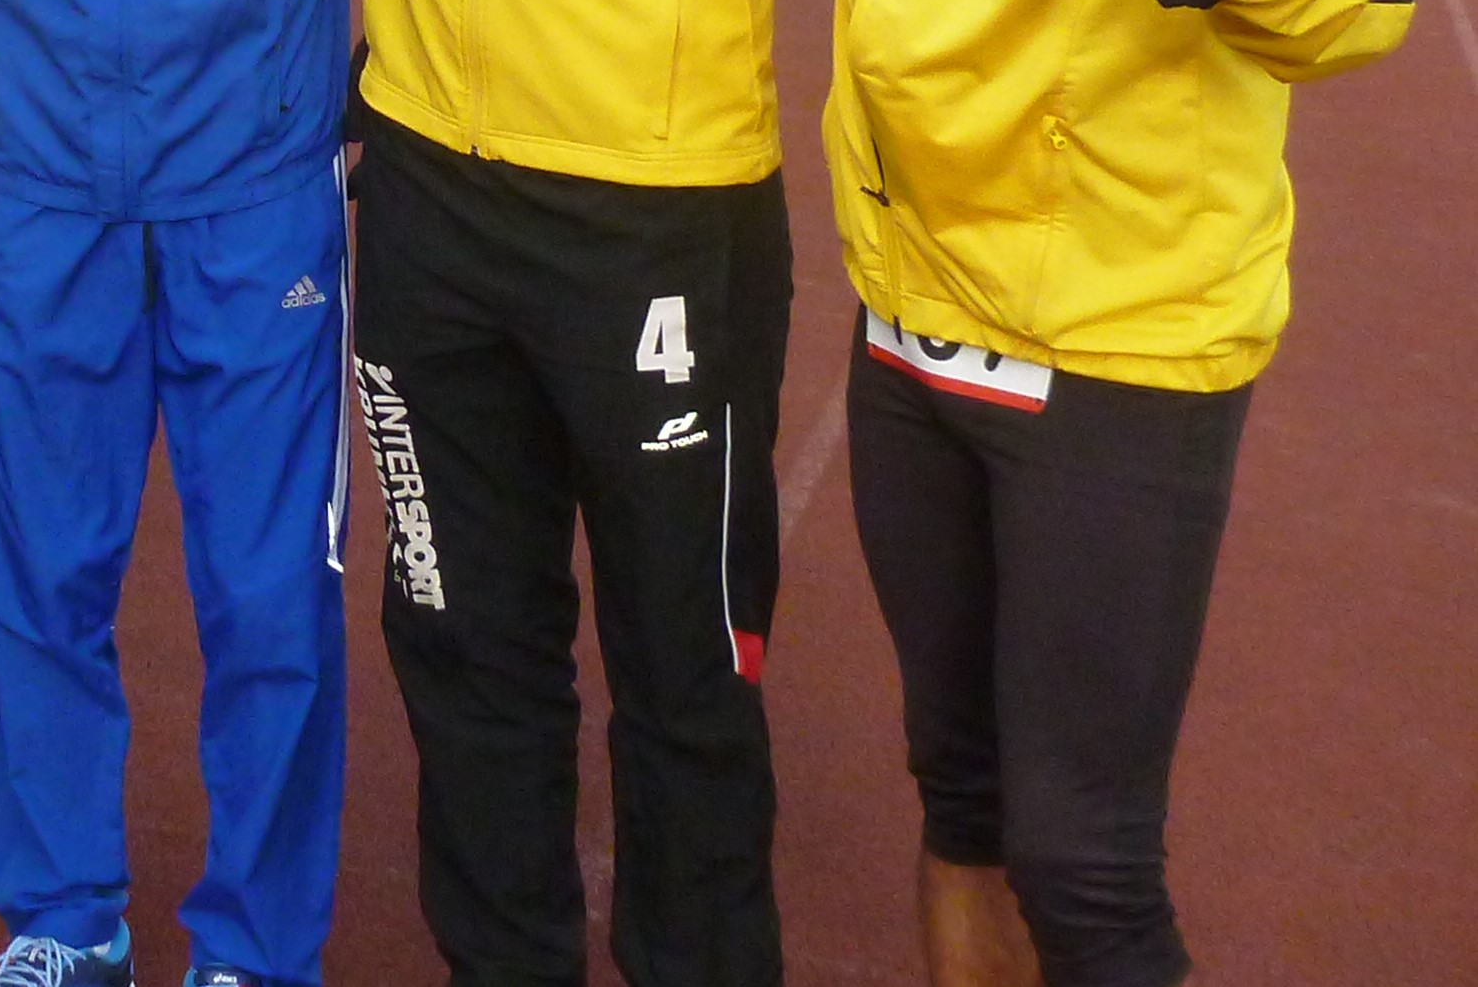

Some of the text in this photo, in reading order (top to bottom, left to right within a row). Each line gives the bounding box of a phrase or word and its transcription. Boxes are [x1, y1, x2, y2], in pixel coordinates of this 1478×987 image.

[281, 292, 326, 309] adidas
[635, 295, 696, 384] 4
[641, 430, 709, 451] PRO TOUCH
[372, 394, 446, 610] INTERSPORT
